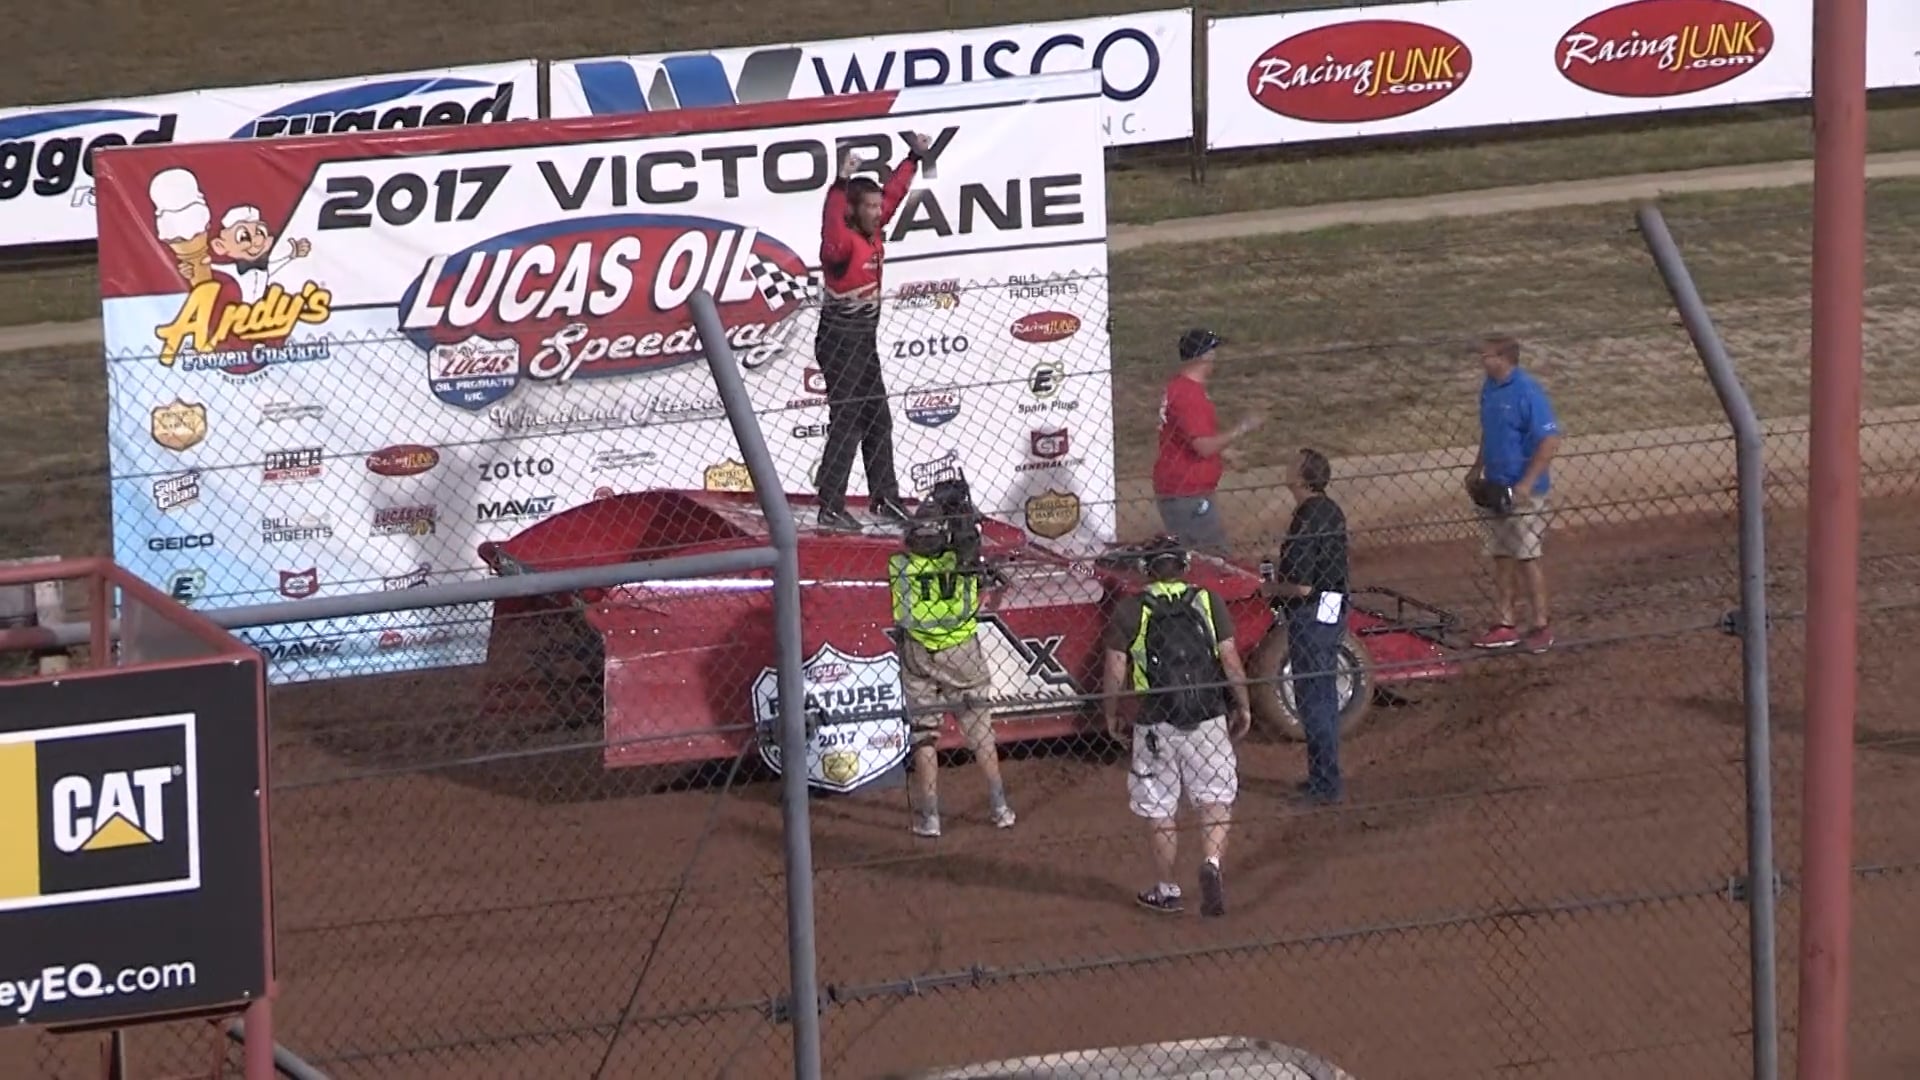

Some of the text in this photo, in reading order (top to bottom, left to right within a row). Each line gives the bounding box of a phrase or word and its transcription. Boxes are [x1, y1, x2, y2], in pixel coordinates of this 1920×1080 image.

[318, 126, 960, 231] 2017 VICTORY
[882, 173, 1084, 242] ANE
[404, 227, 760, 328] LUCAS OIL
[155, 280, 332, 368] Andy's
[182, 337, 331, 372] Frozen Custard
[529, 321, 796, 384] Speeday
[893, 335, 969, 358] zotto
[440, 354, 514, 377] LUCAS
[1018, 402, 1047, 415] Spark
[792, 423, 831, 439] GEI
[479, 456, 554, 481] zotto
[262, 517, 291, 530] BILL
[263, 526, 333, 543] ROBERTS
[149, 533, 213, 551] GEICO
[916, 574, 957, 600] TV
[819, 731, 857, 748] 2017
[52, 766, 172, 852] CAT
